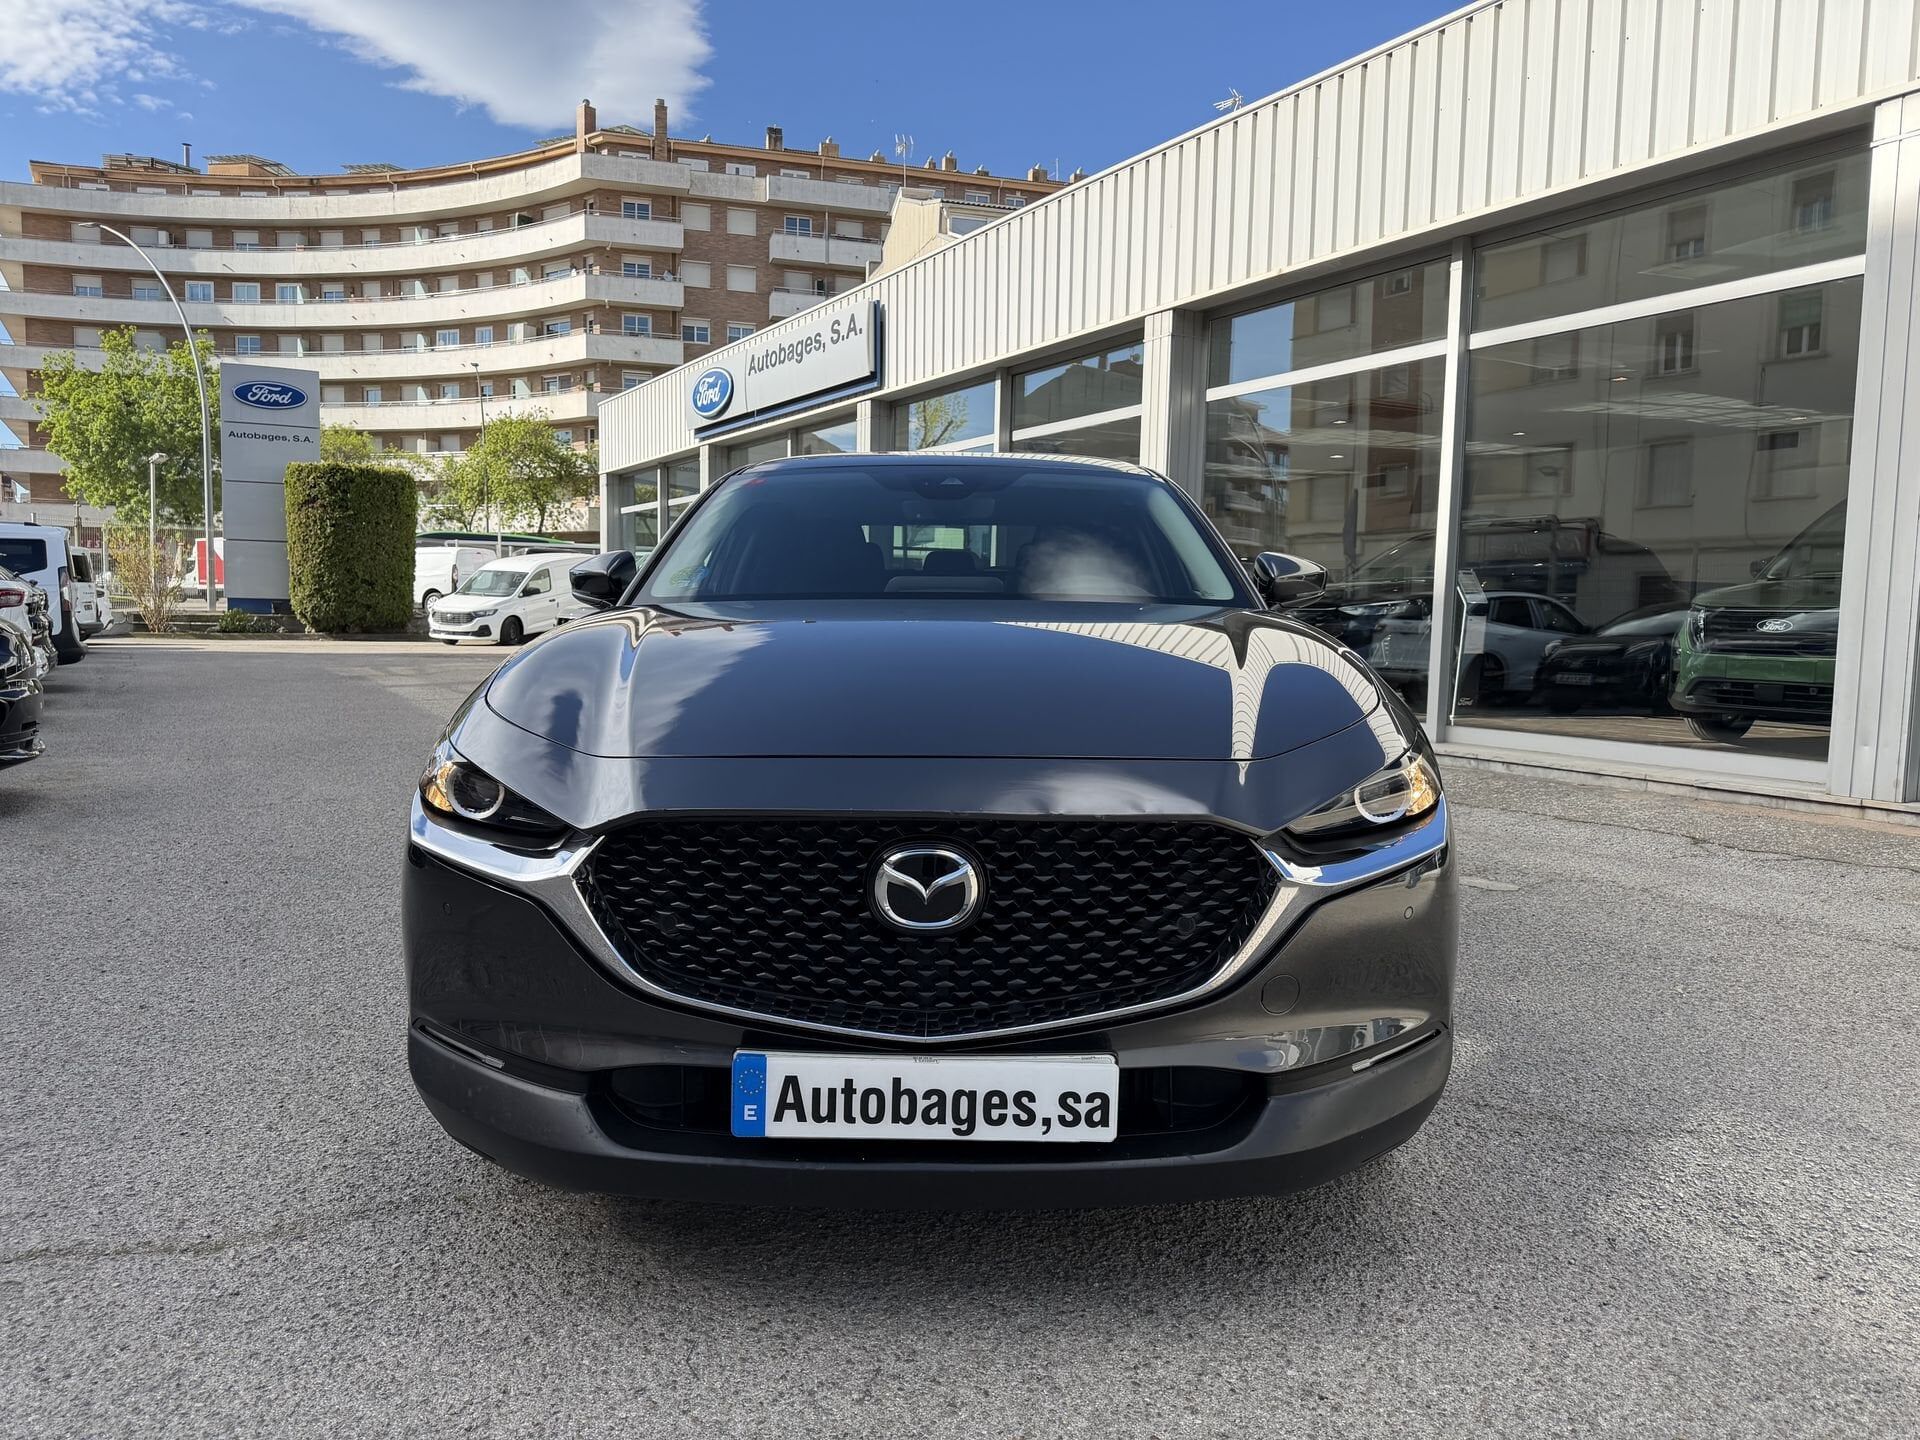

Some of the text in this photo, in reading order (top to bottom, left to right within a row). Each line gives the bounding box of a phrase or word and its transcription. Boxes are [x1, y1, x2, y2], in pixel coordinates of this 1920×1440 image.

[748, 313, 863, 376] Autobages, S.A.
[248, 385, 292, 404] Ford
[697, 376, 721, 407] Ford
[229, 431, 314, 444] Autobages, S.A.
[743, 1075, 1110, 1136] E Autobages,sa
